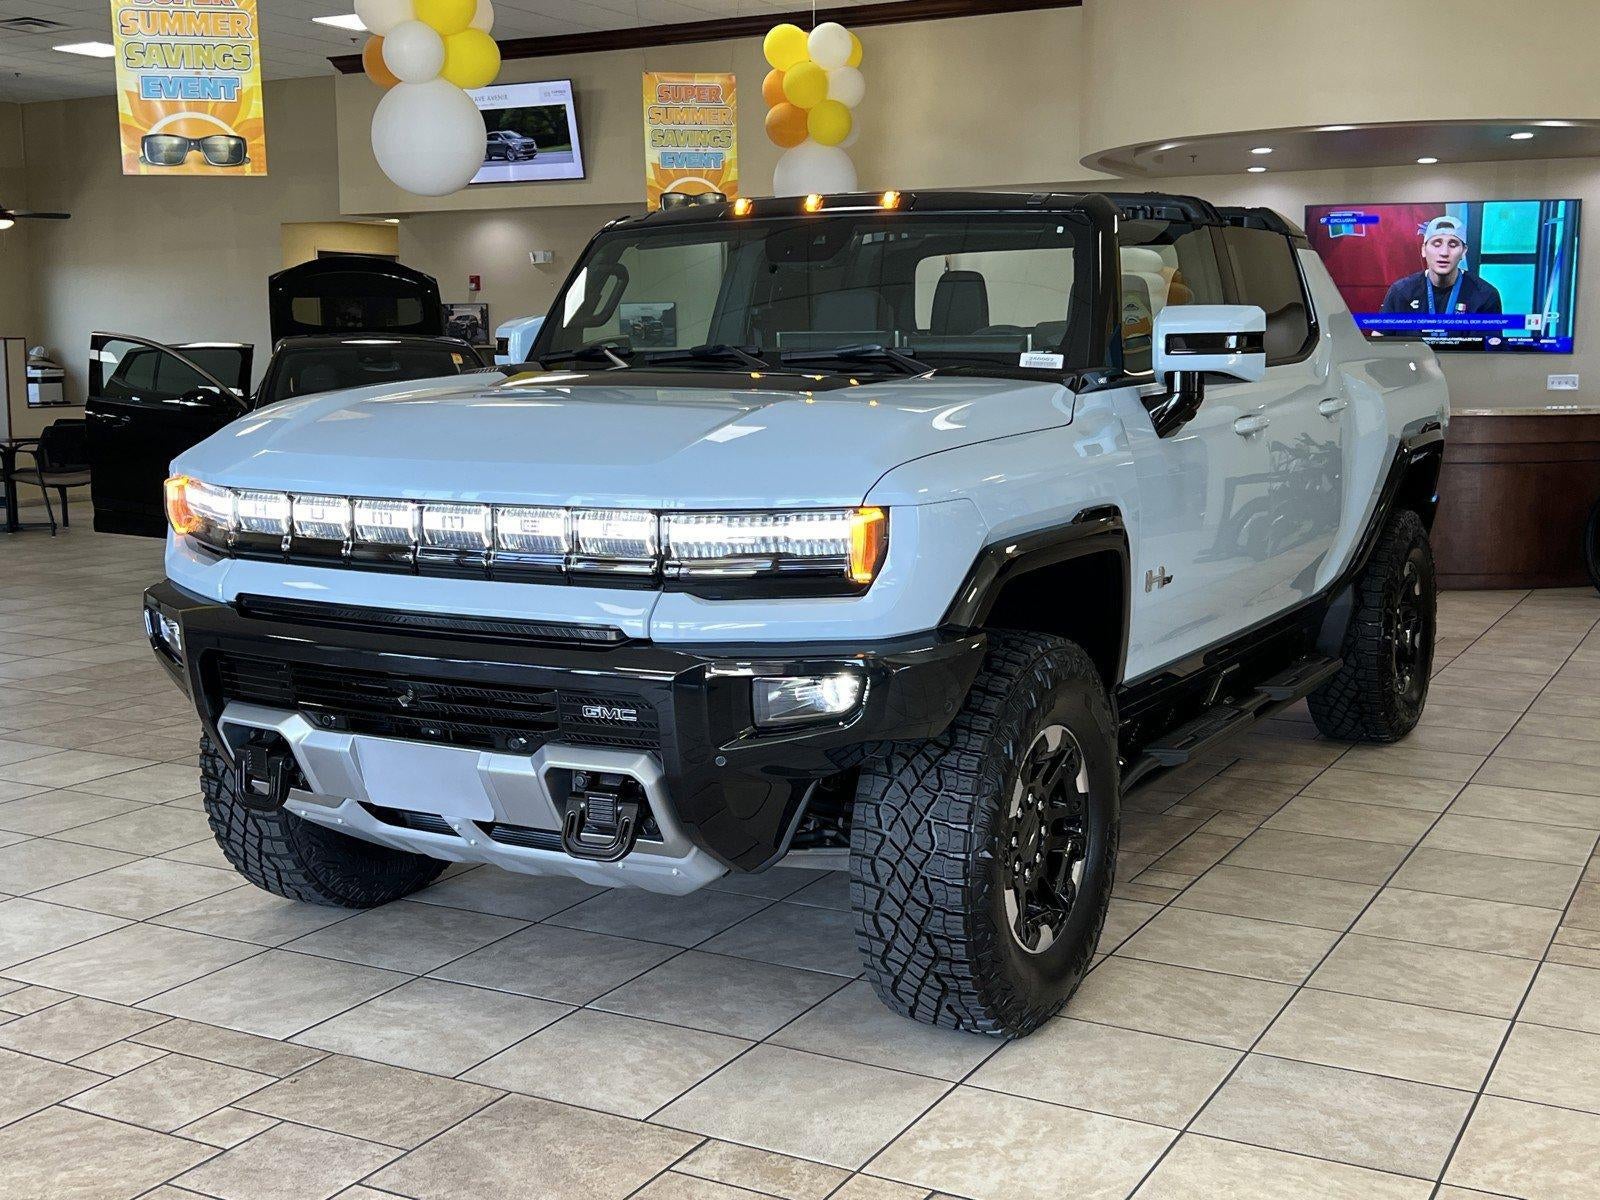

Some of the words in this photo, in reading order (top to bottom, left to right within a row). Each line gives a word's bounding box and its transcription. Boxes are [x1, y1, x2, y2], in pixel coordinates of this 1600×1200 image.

[119, 10, 252, 38] SUMMER
[125, 42, 251, 71] SAVINGS
[140, 75, 239, 100] EVENT
[658, 84, 723, 103] SUPER
[649, 107, 733, 125] SUMMER
[651, 129, 732, 148] SAVINGS
[660, 151, 724, 168] EVENT
[582, 705, 638, 721] GMC
